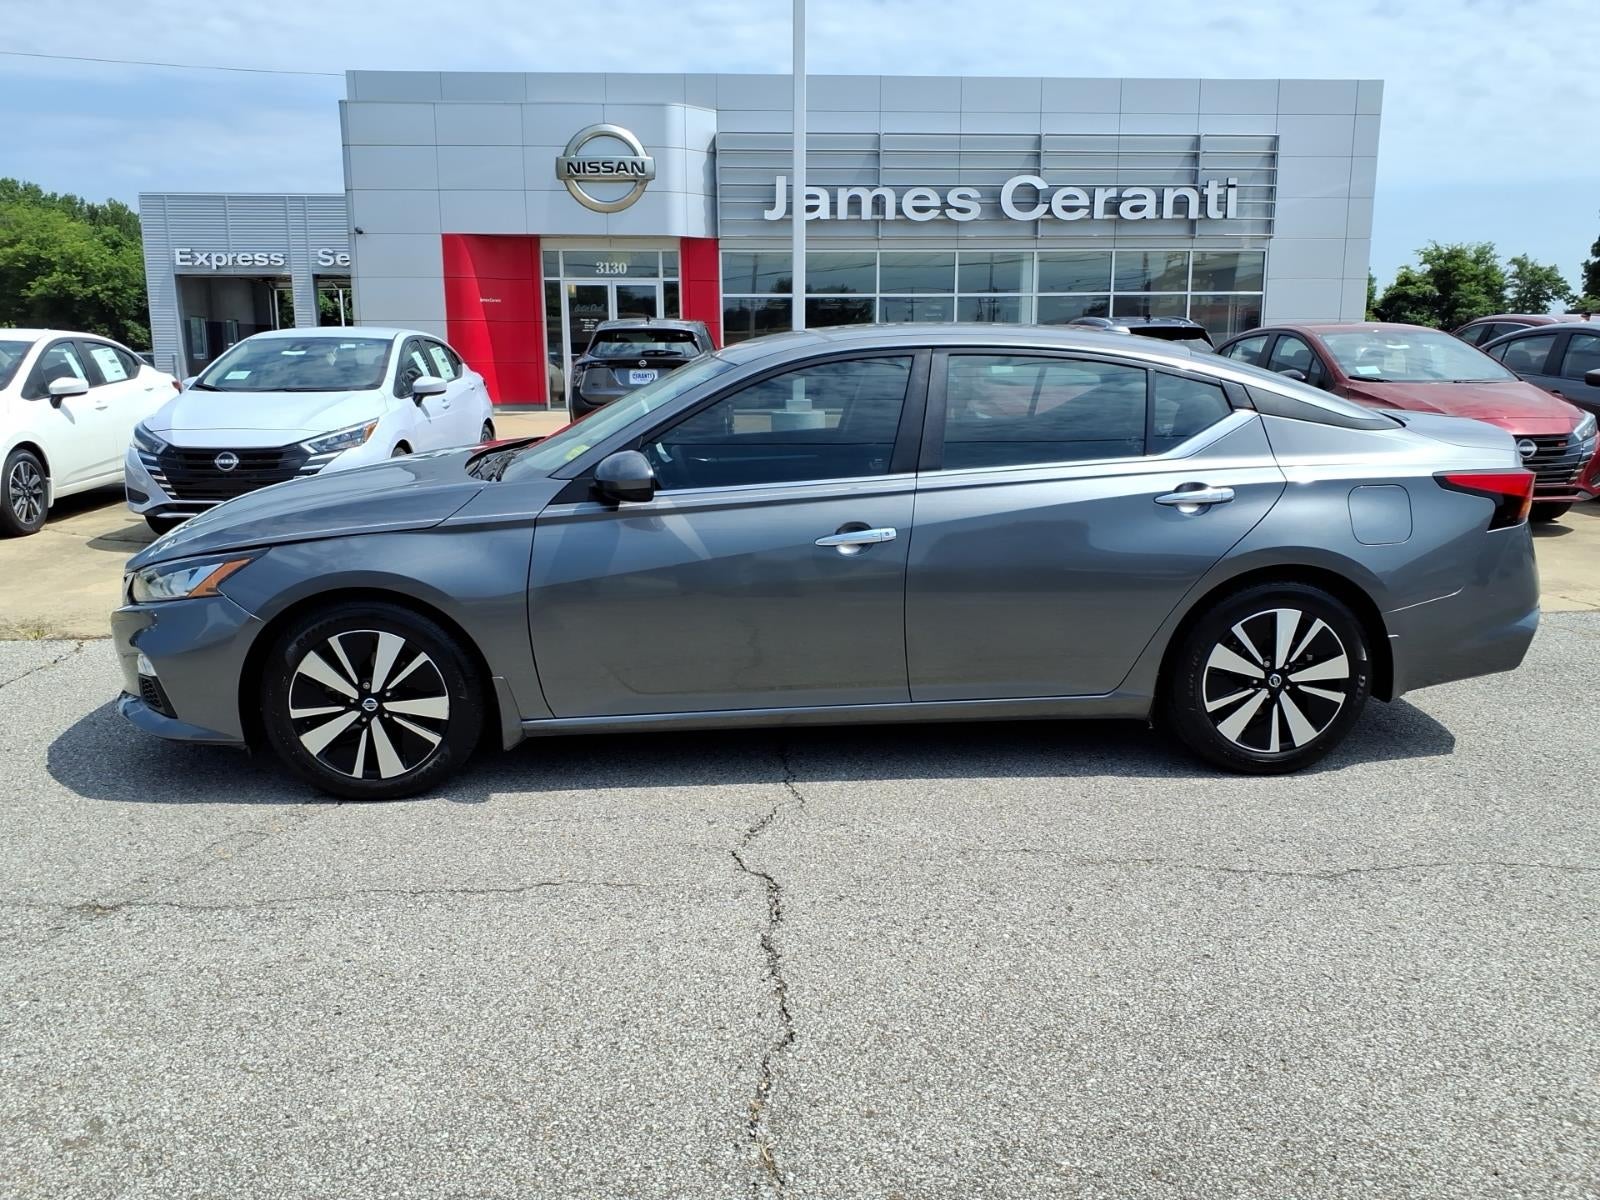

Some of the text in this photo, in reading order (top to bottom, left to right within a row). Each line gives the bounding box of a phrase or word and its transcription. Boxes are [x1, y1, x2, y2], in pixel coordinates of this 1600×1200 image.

[566, 161, 646, 175] NISSAN
[764, 174, 1238, 222] James Ceranti
[174, 247, 351, 270] Express Se
[595, 260, 628, 274] 3130
